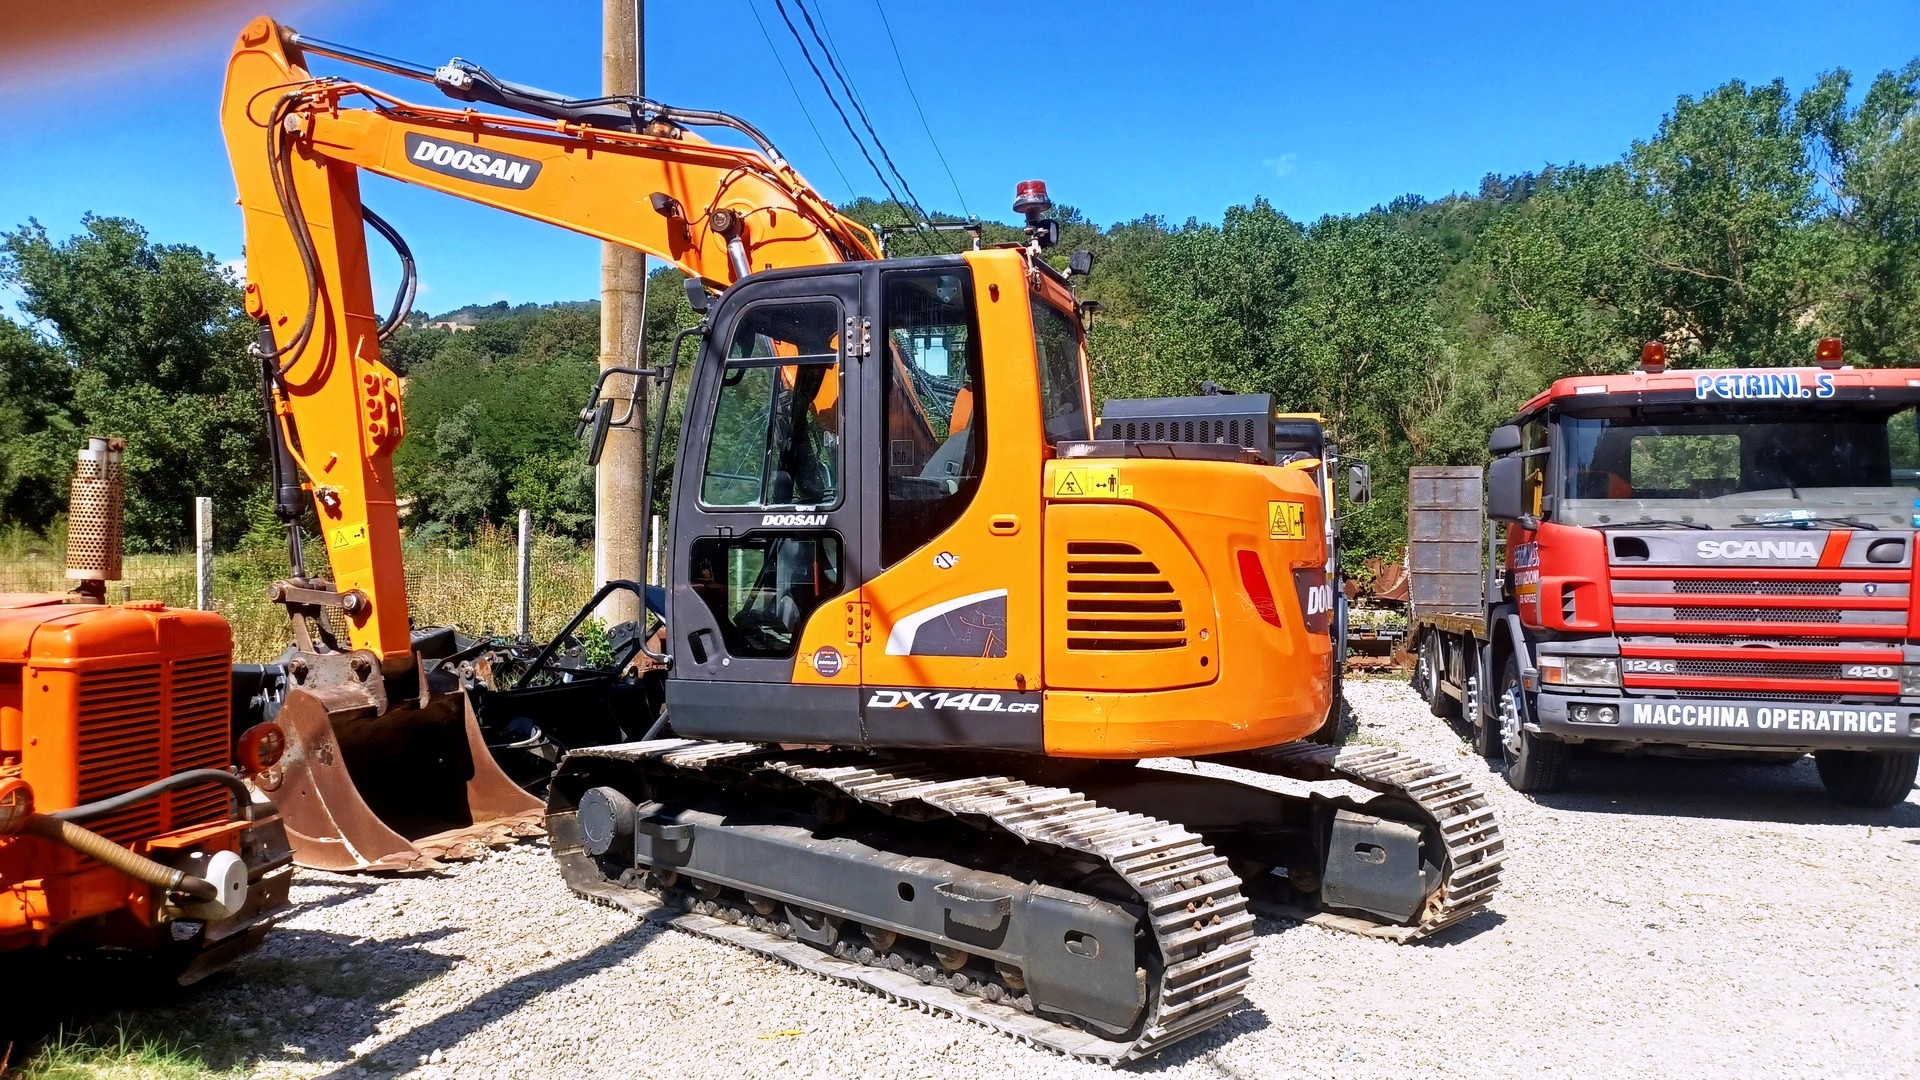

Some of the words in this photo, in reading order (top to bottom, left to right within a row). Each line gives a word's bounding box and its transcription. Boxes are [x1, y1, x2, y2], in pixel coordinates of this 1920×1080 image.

[413, 140, 531, 184] DOOSAN
[1816, 373, 1836, 398] S
[761, 514, 829, 526] DOOSAN
[1696, 540, 1819, 559] SCANIA
[1847, 666, 1894, 678] 420
[1633, 703, 1750, 728] MACCHINA
[1757, 708, 1897, 733] OPERATRICE
